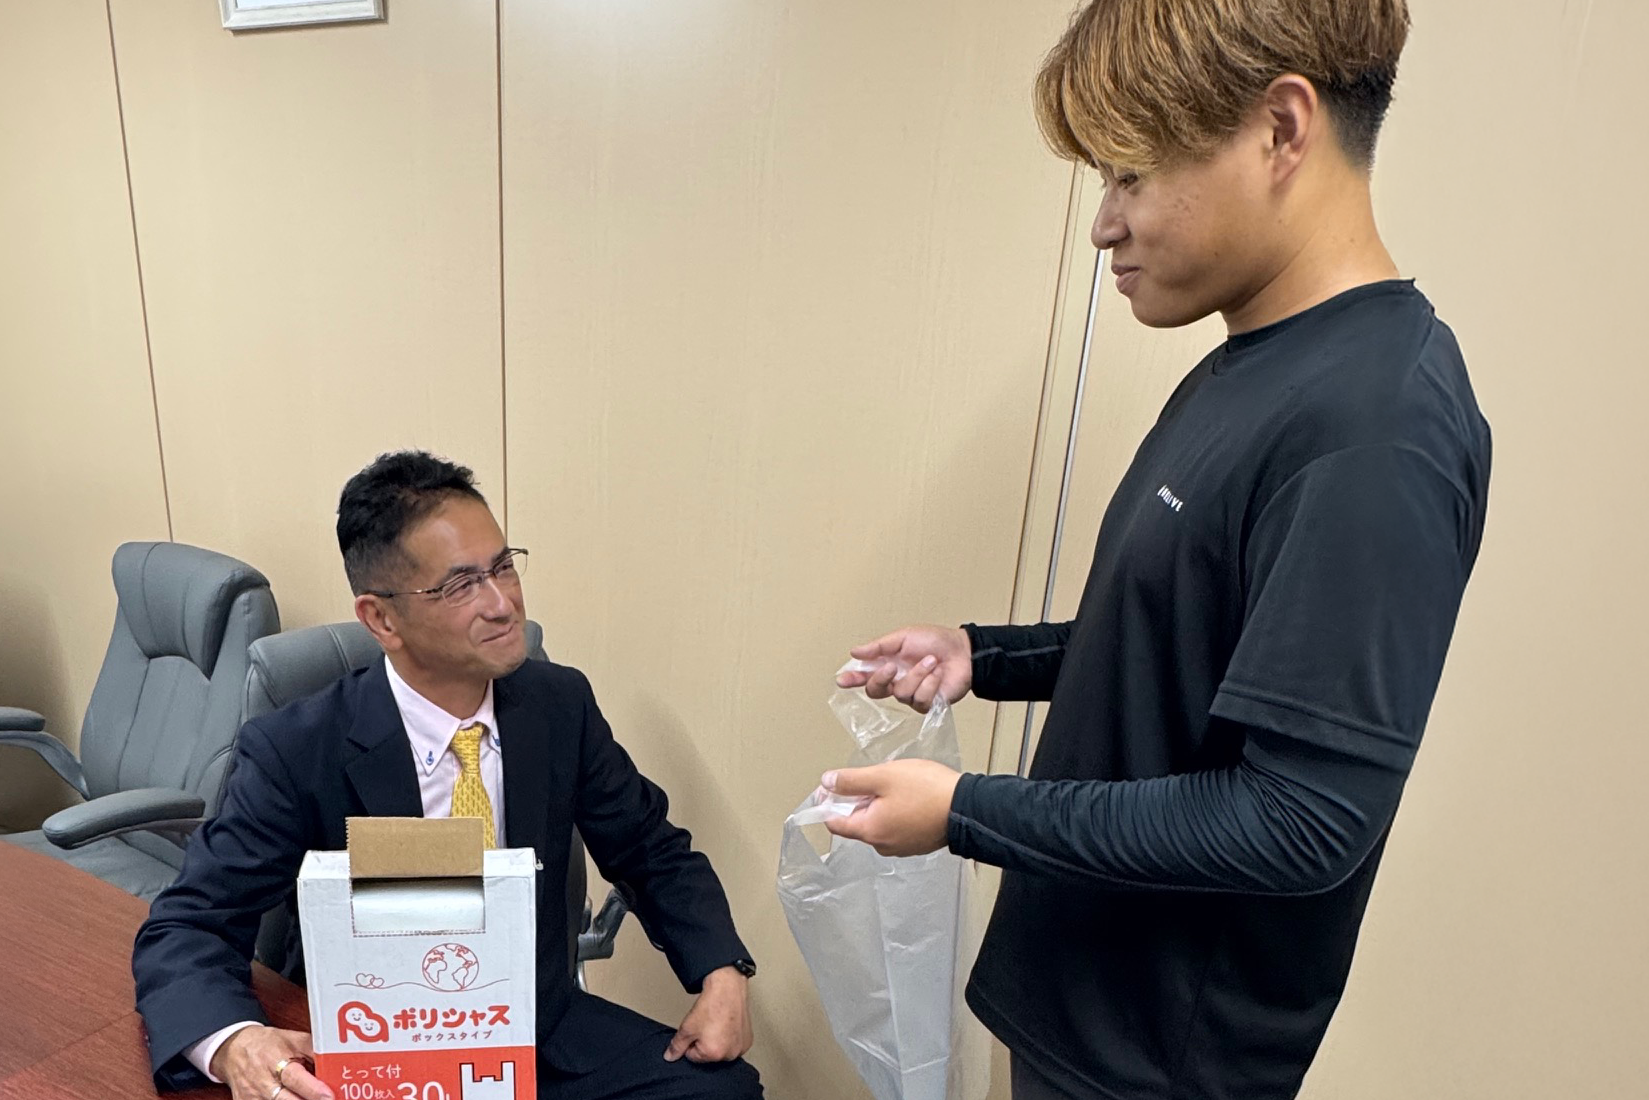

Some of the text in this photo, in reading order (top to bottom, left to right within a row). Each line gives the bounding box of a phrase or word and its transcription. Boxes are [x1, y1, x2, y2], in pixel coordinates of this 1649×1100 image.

[393, 1005, 510, 1030] ポリシャス
[411, 1030, 492, 1042] ボックスタイプ
[341, 1064, 401, 1080] とって付
[340, 1082, 395, 1100] 100枚入
